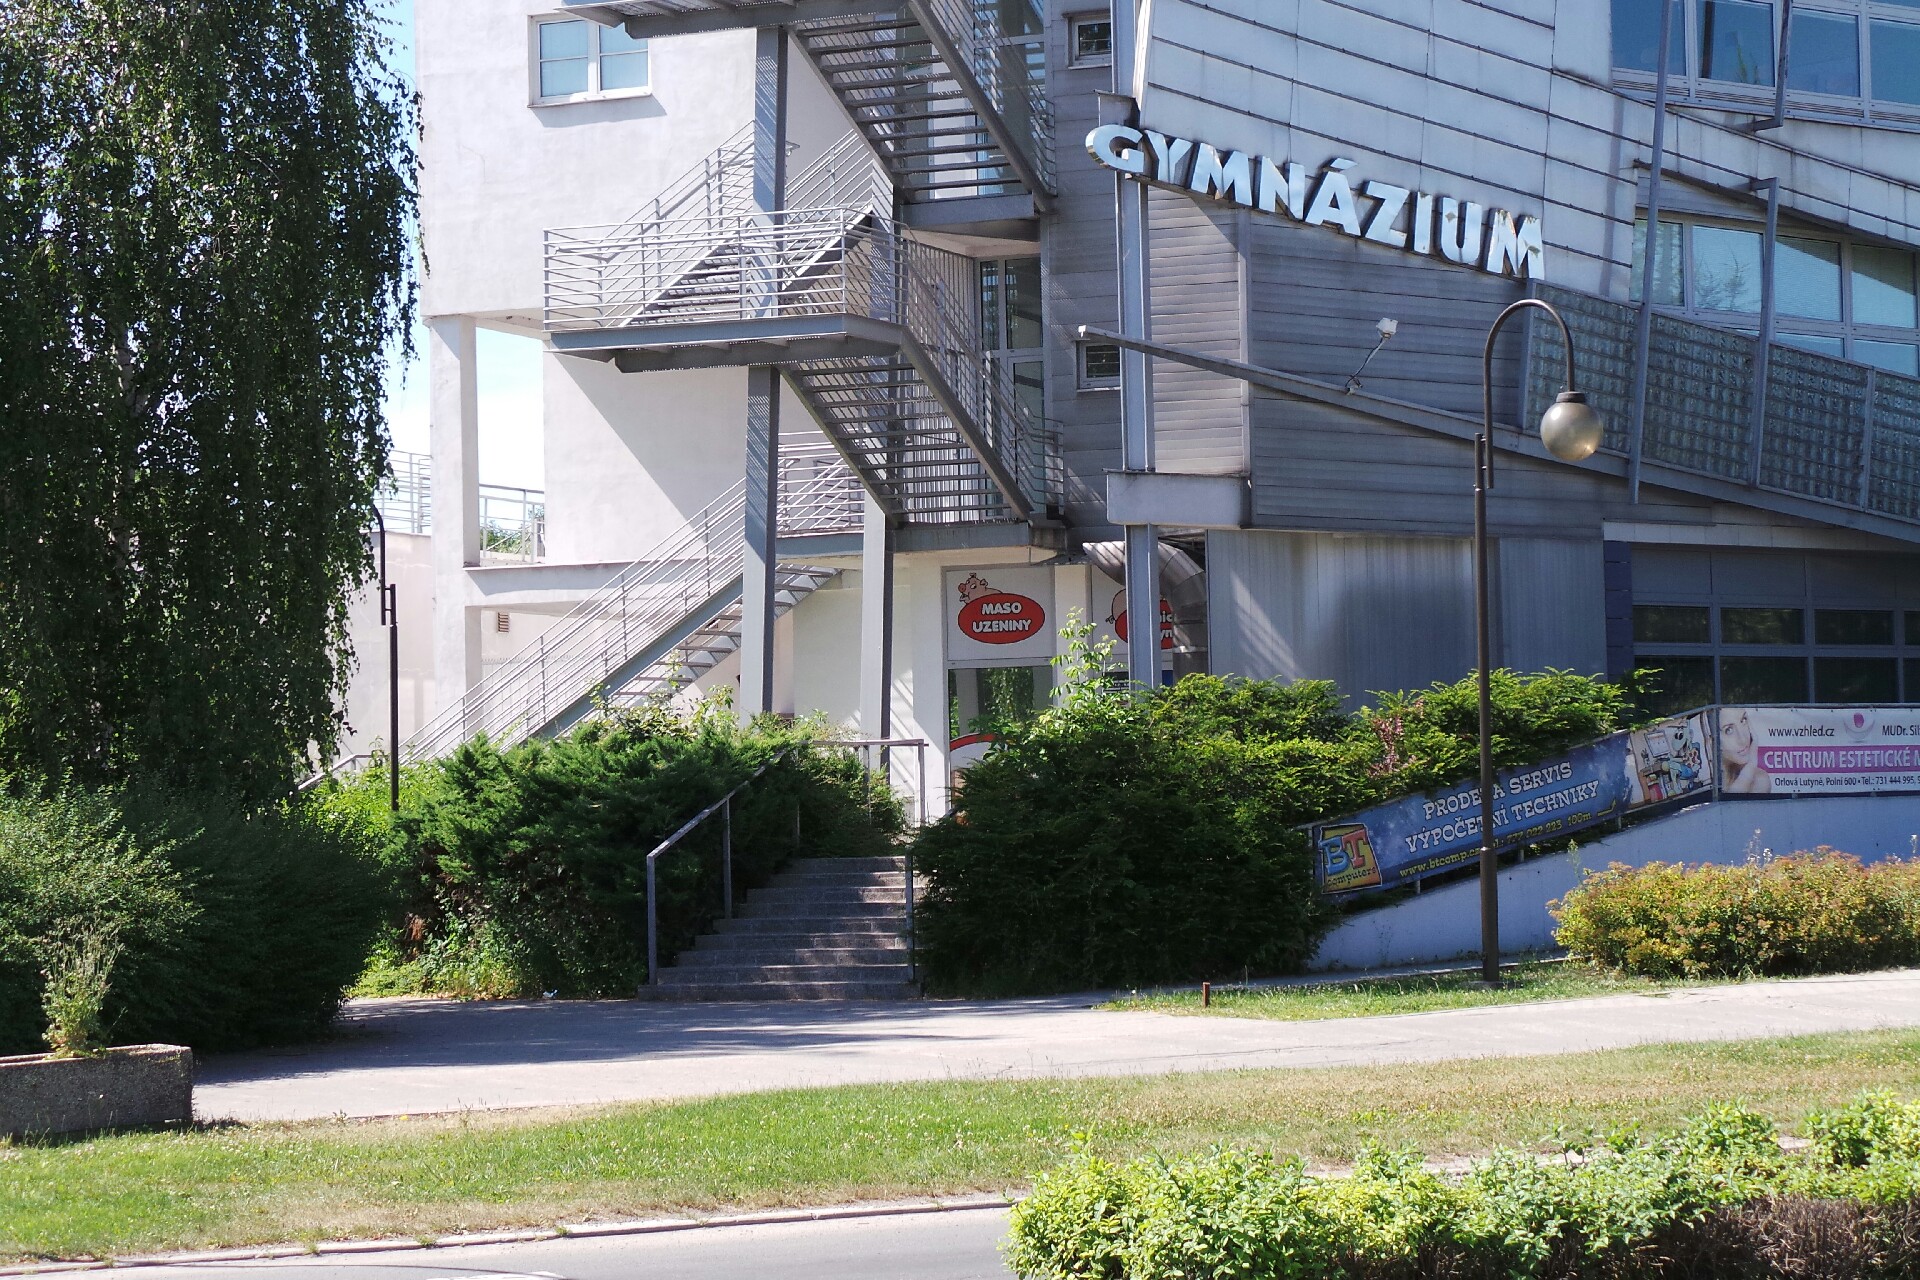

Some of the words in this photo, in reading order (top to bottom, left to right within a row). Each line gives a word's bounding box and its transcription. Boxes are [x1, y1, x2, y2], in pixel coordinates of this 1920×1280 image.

[1085, 124, 1545, 280] GYMNÁZIUM
[981, 601, 1022, 615] MASO
[972, 618, 1032, 633] UZENINY
[1768, 724, 1835, 737] www.vzhled.cz
[1881, 724, 1908, 736] MUDr.
[1763, 750, 1835, 769] CENTRUM
[1839, 746, 1911, 768] ESTETICKÉ
[1422, 787, 1482, 821] PRODE
[1492, 783, 1506, 800] A
[1509, 762, 1573, 795] SERVIS
[1774, 777, 1798, 787] Orlová
[1825, 777, 1843, 786] Polní
[1875, 776, 1888, 785] 731
[1889, 776, 1901, 785] 444
[1511, 780, 1599, 821] TECHNIKY
[1317, 829, 1368, 876] BT
[1400, 847, 1481, 877] www.btcomp.cz
[1567, 812, 1592, 826] 100m
[1327, 866, 1376, 886] computers
